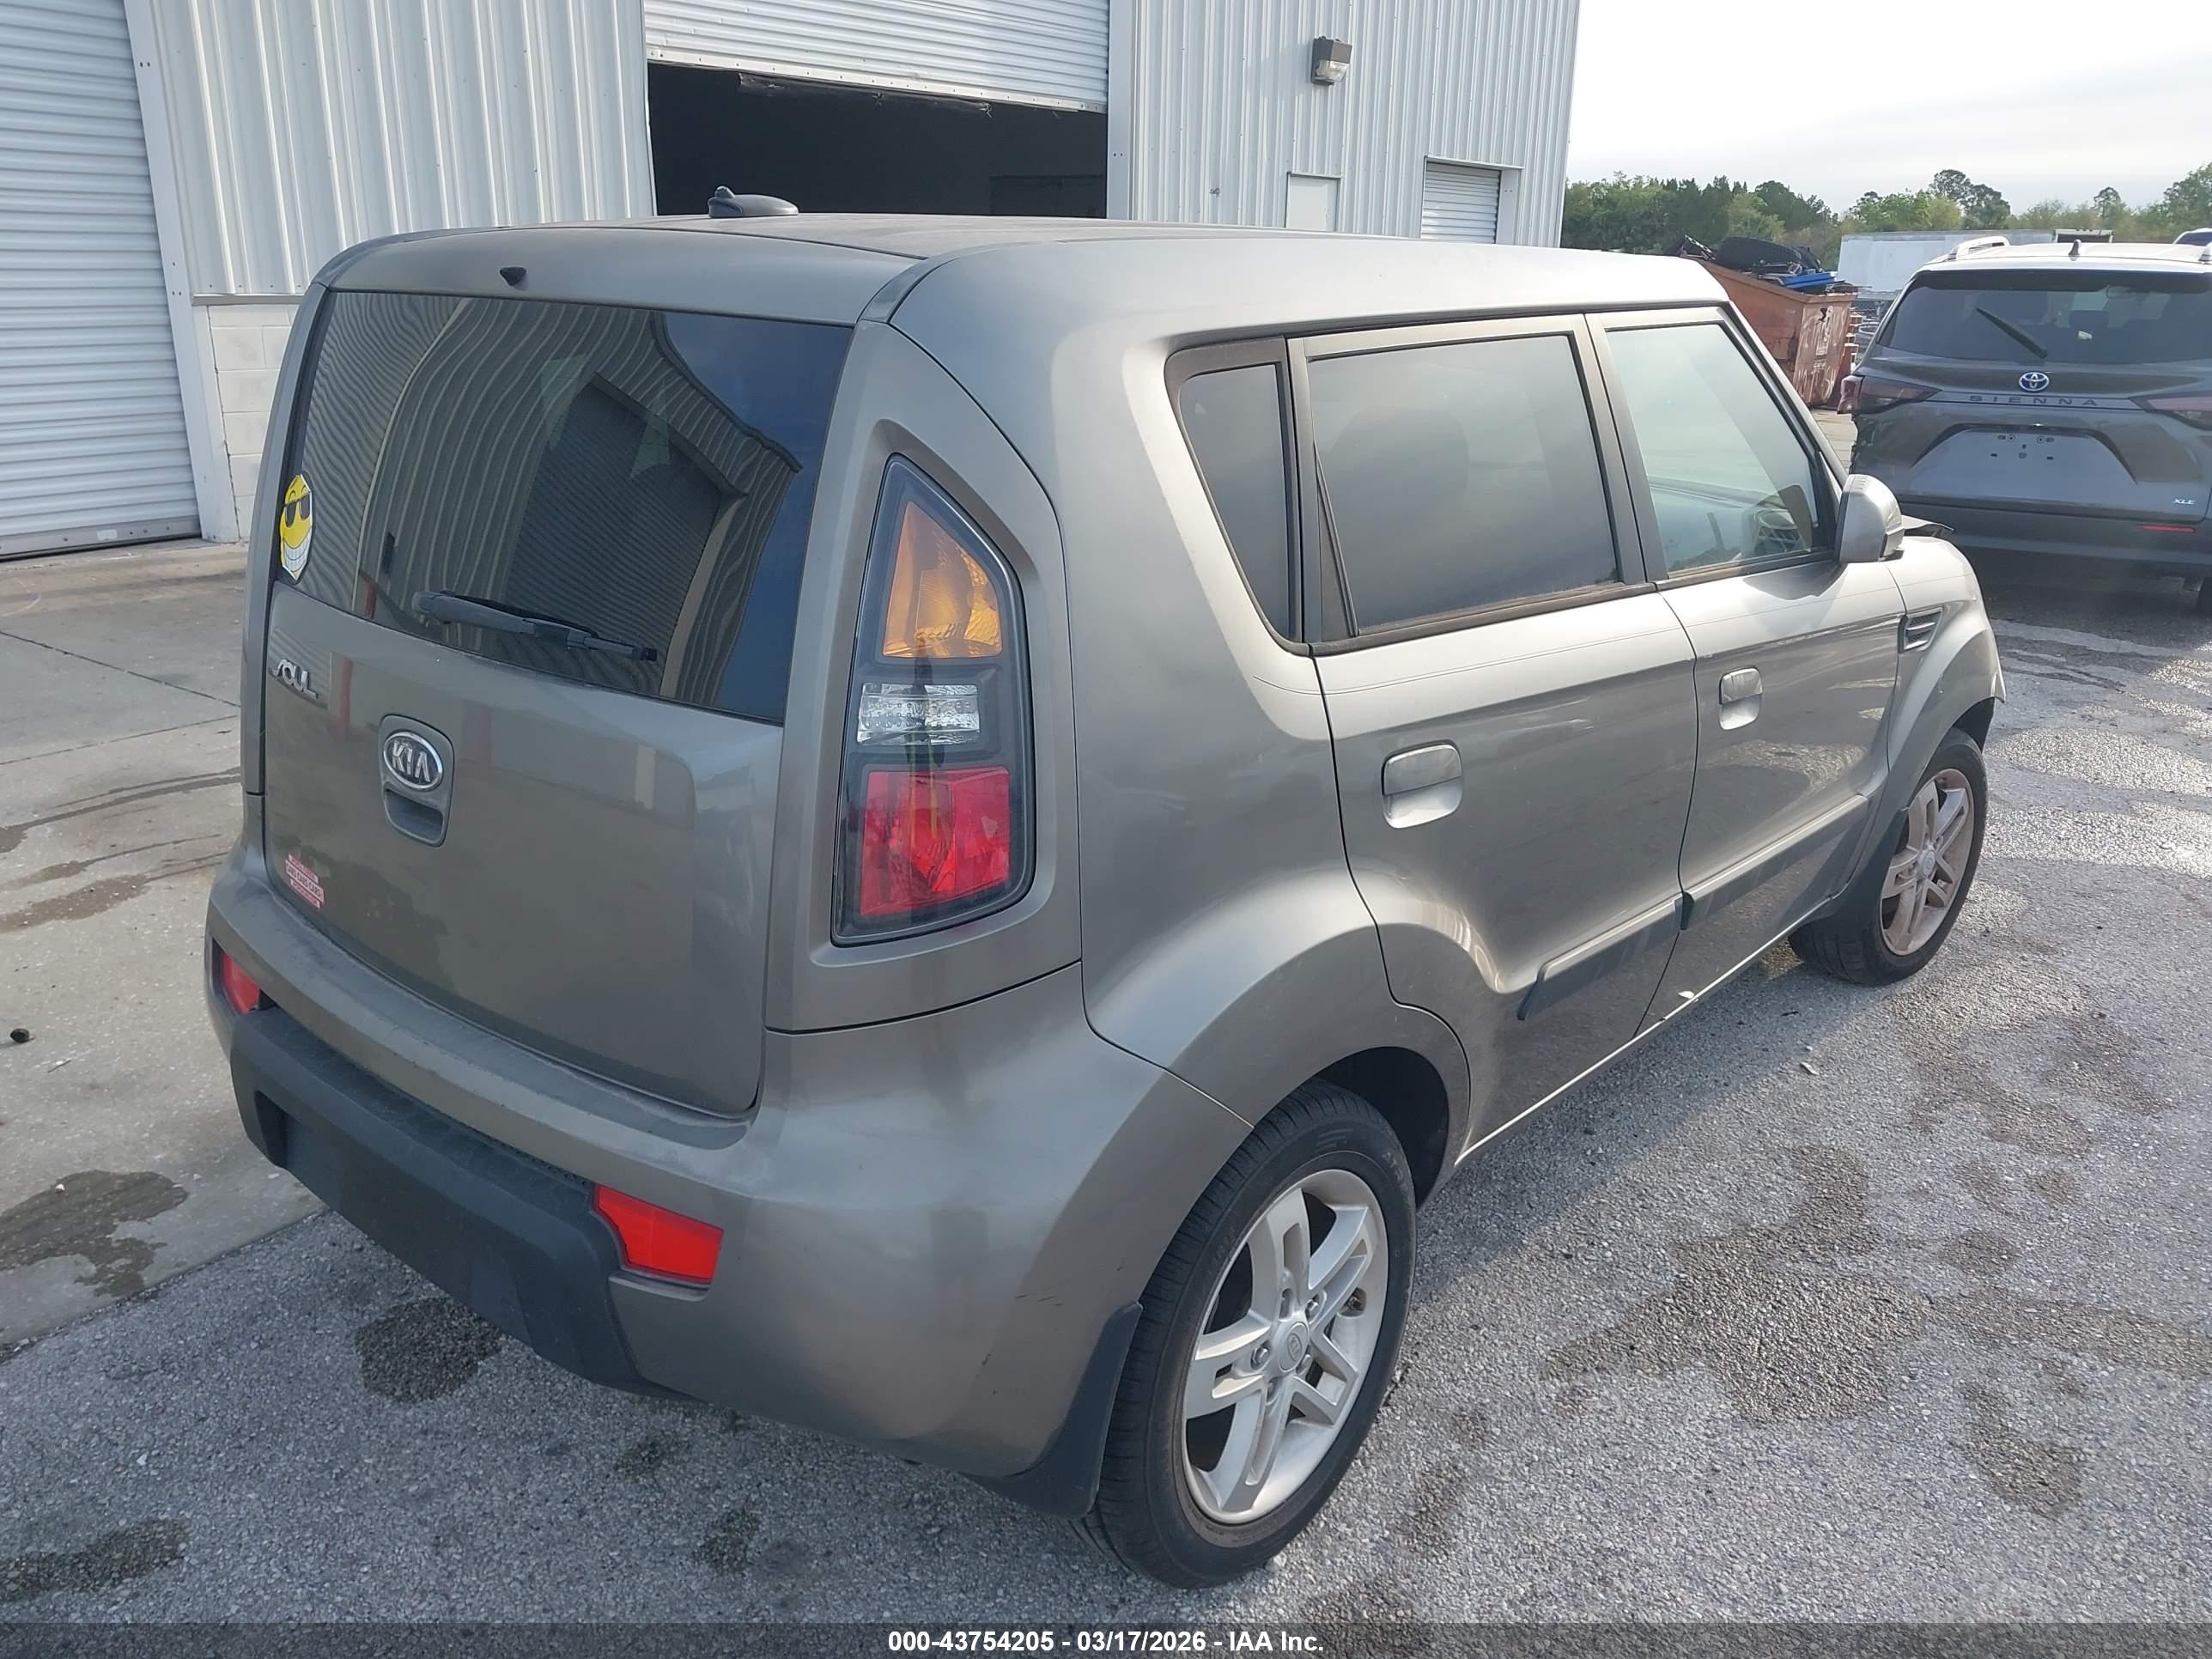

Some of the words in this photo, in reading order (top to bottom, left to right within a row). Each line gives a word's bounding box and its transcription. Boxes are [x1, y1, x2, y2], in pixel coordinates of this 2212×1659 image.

[1969, 395, 2098, 406] SIENNA
[272, 659, 319, 702] SOUL
[392, 739, 431, 782] KIA
